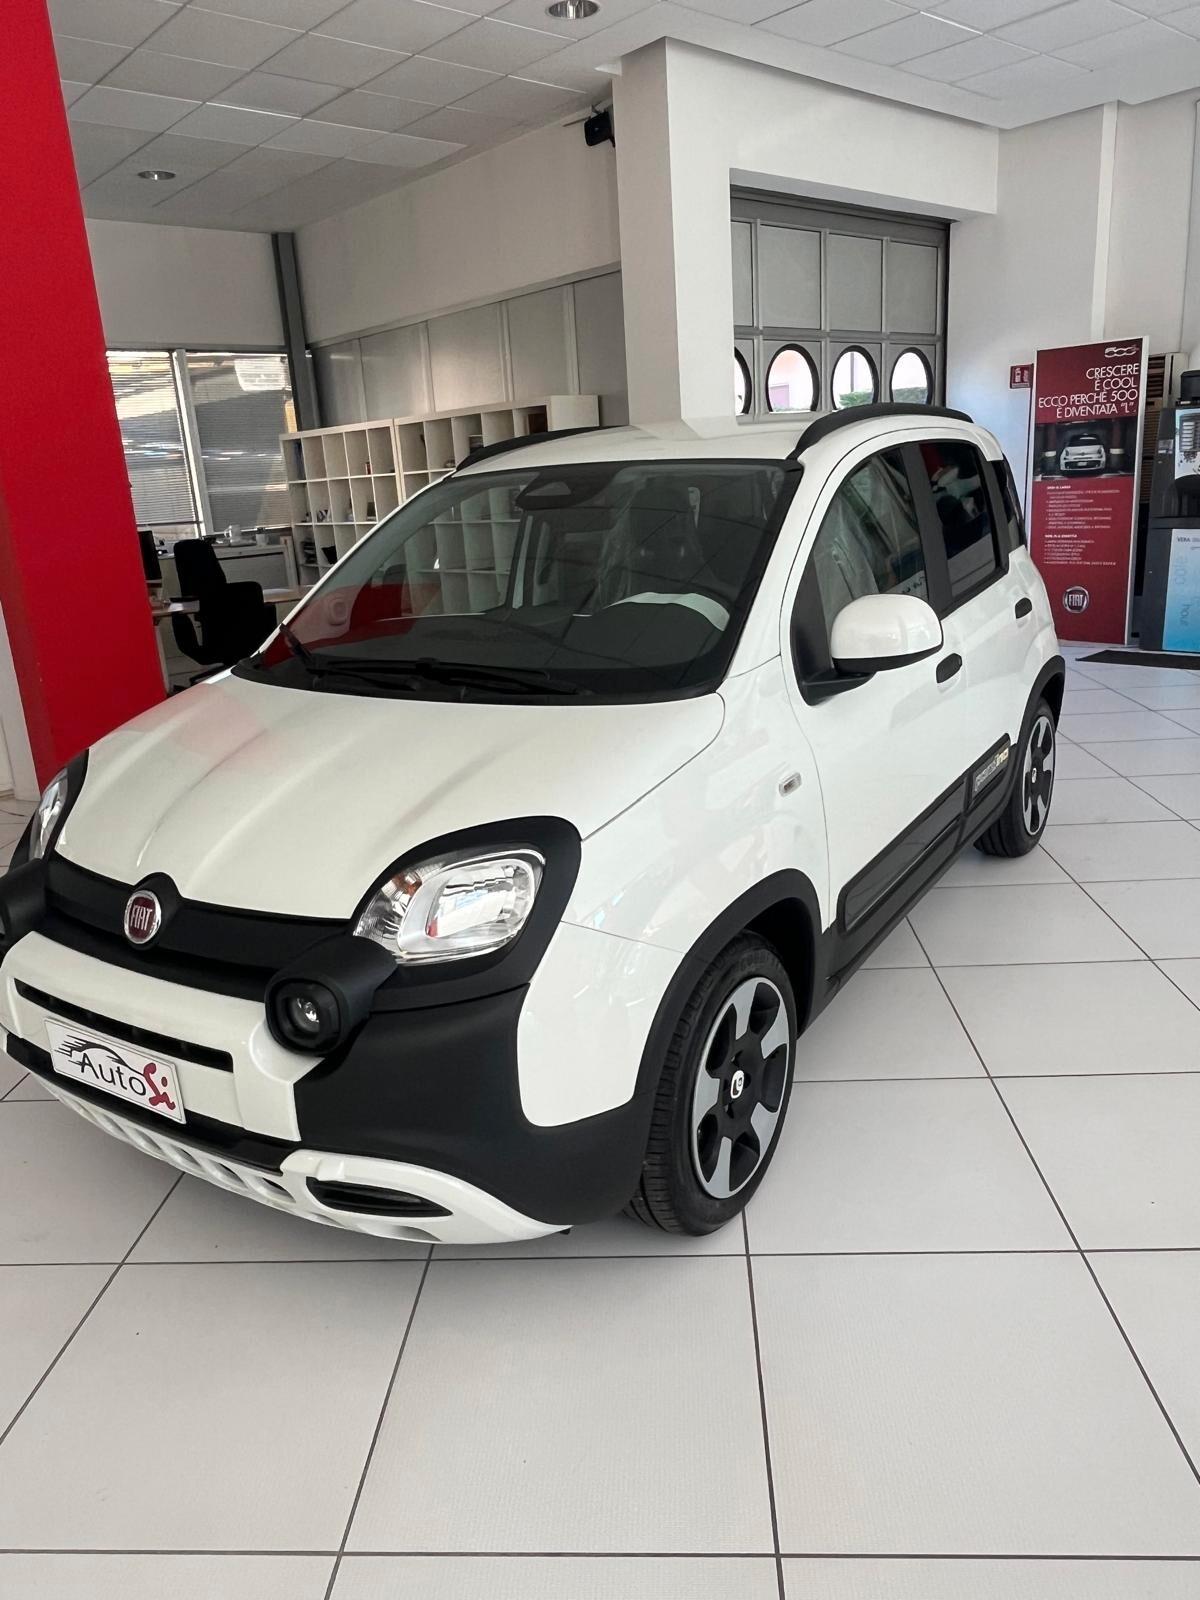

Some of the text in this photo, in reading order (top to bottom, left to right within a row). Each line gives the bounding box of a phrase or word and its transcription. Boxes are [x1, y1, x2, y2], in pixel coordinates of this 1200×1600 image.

[1086, 363, 1140, 379] CRESCERE
[1103, 377, 1138, 390] COOL
[1038, 395, 1068, 408] ECCO
[1110, 389, 1138, 402] 500
[1064, 403, 1118, 418] DIVENTATA
[1069, 594, 1084, 606] FIAT
[130, 904, 153, 930] FIAT
